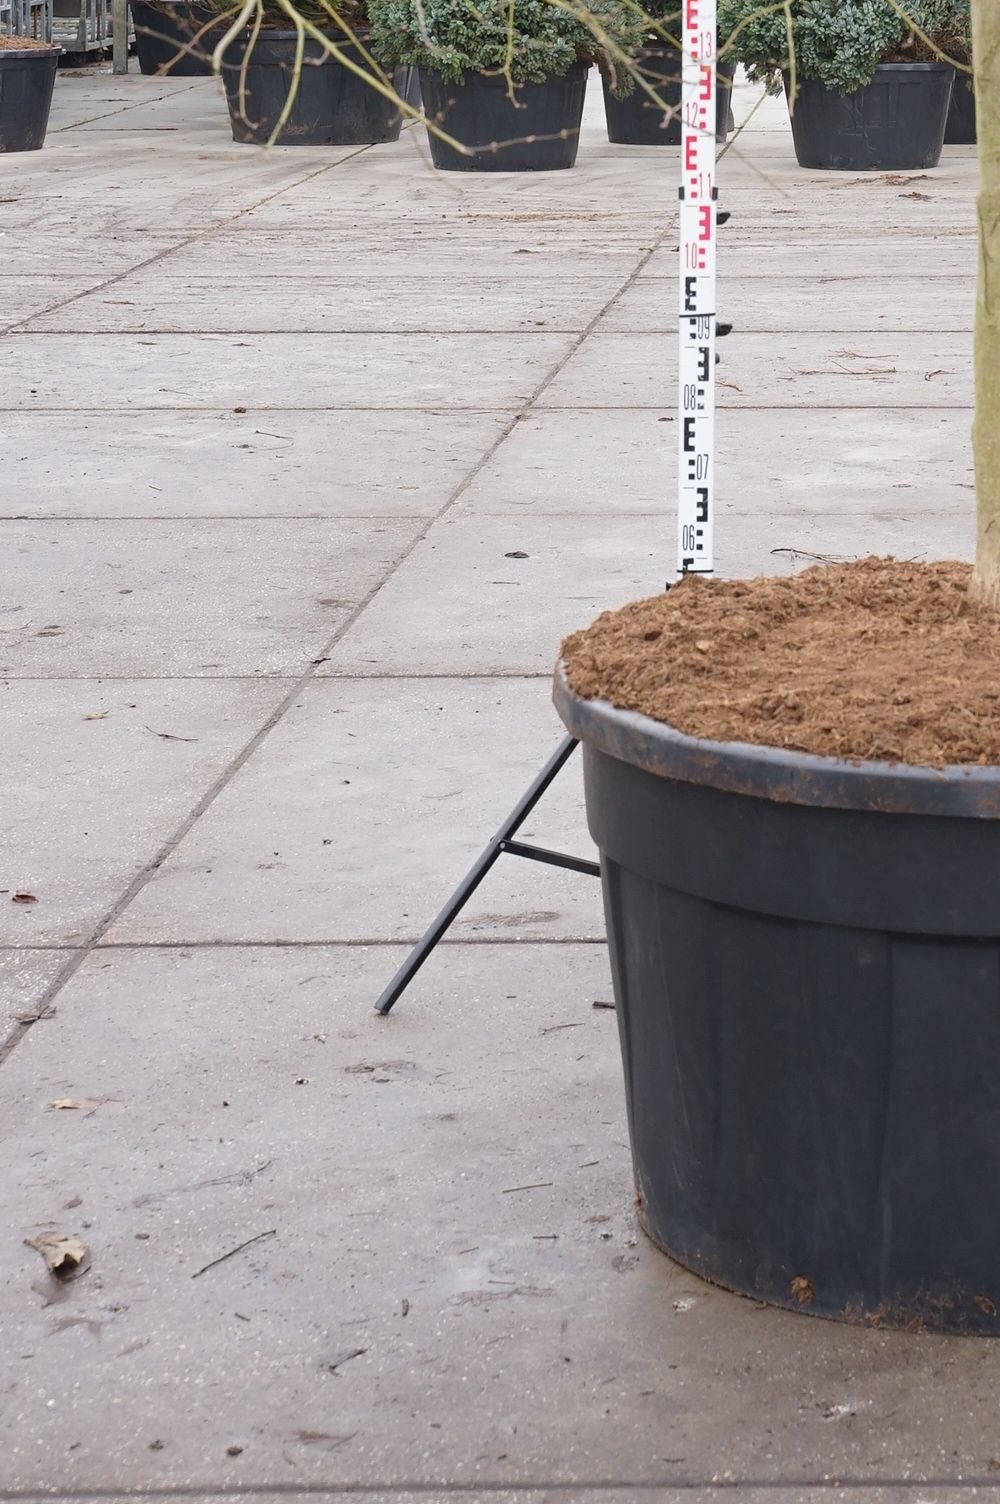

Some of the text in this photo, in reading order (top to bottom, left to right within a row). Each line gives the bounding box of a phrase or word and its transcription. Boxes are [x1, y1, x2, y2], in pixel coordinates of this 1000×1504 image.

[700, 32, 712, 58] 13
[686, 102, 698, 128] 12
[699, 172, 712, 199] 11
[685, 242, 697, 269] 10
[698, 314, 710, 339] 09
[683, 384, 696, 410] 08
[696, 454, 709, 480] 07
[682, 524, 695, 551] 06
